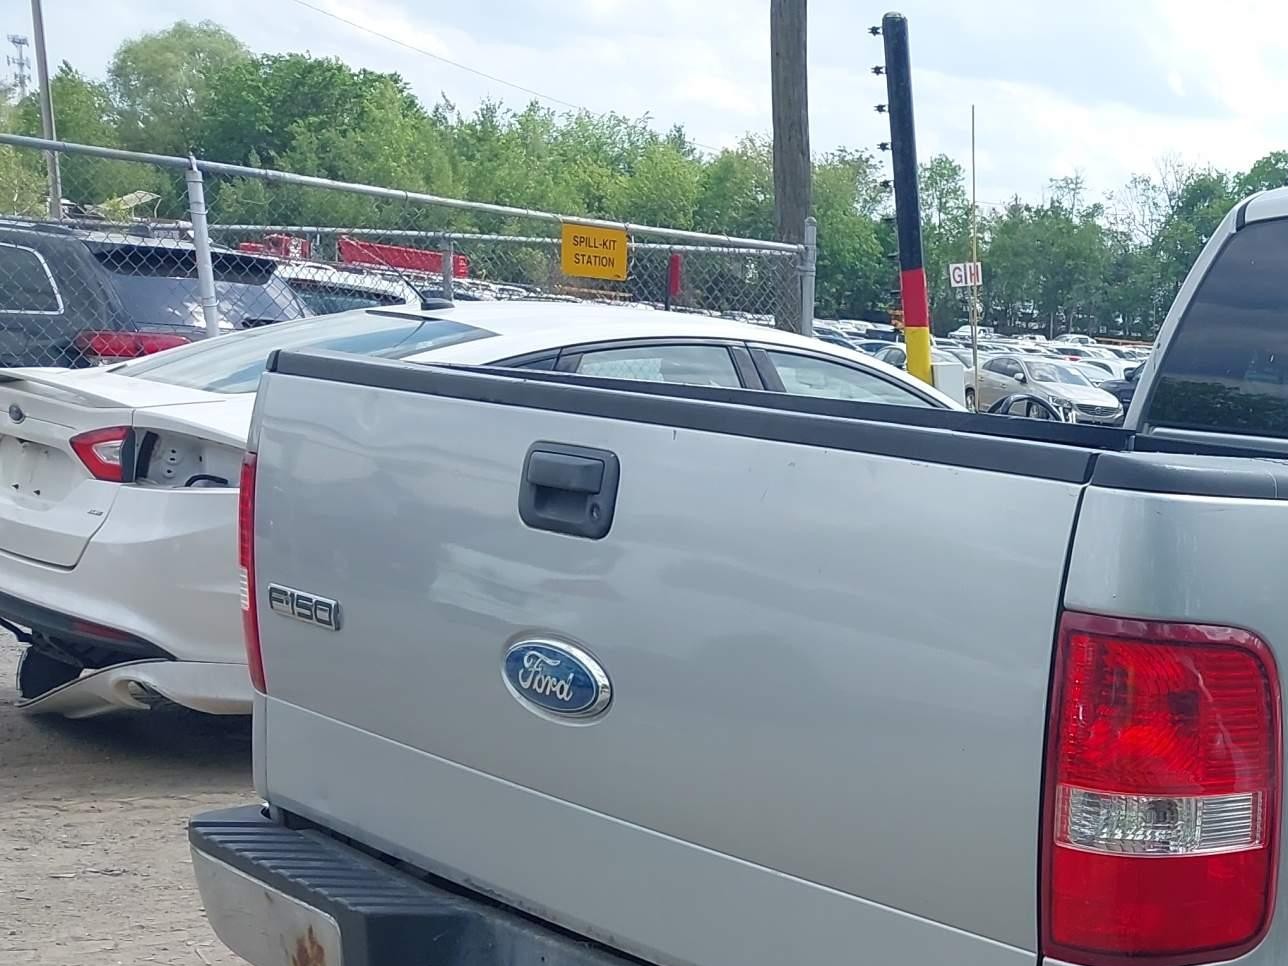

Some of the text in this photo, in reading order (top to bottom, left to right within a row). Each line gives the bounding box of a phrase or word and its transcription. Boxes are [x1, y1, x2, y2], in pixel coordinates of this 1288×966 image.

[572, 234, 618, 251] SPILL-KIT
[573, 252, 616, 269] STATION
[952, 264, 980, 284] G H
[518, 650, 575, 702] Ford
